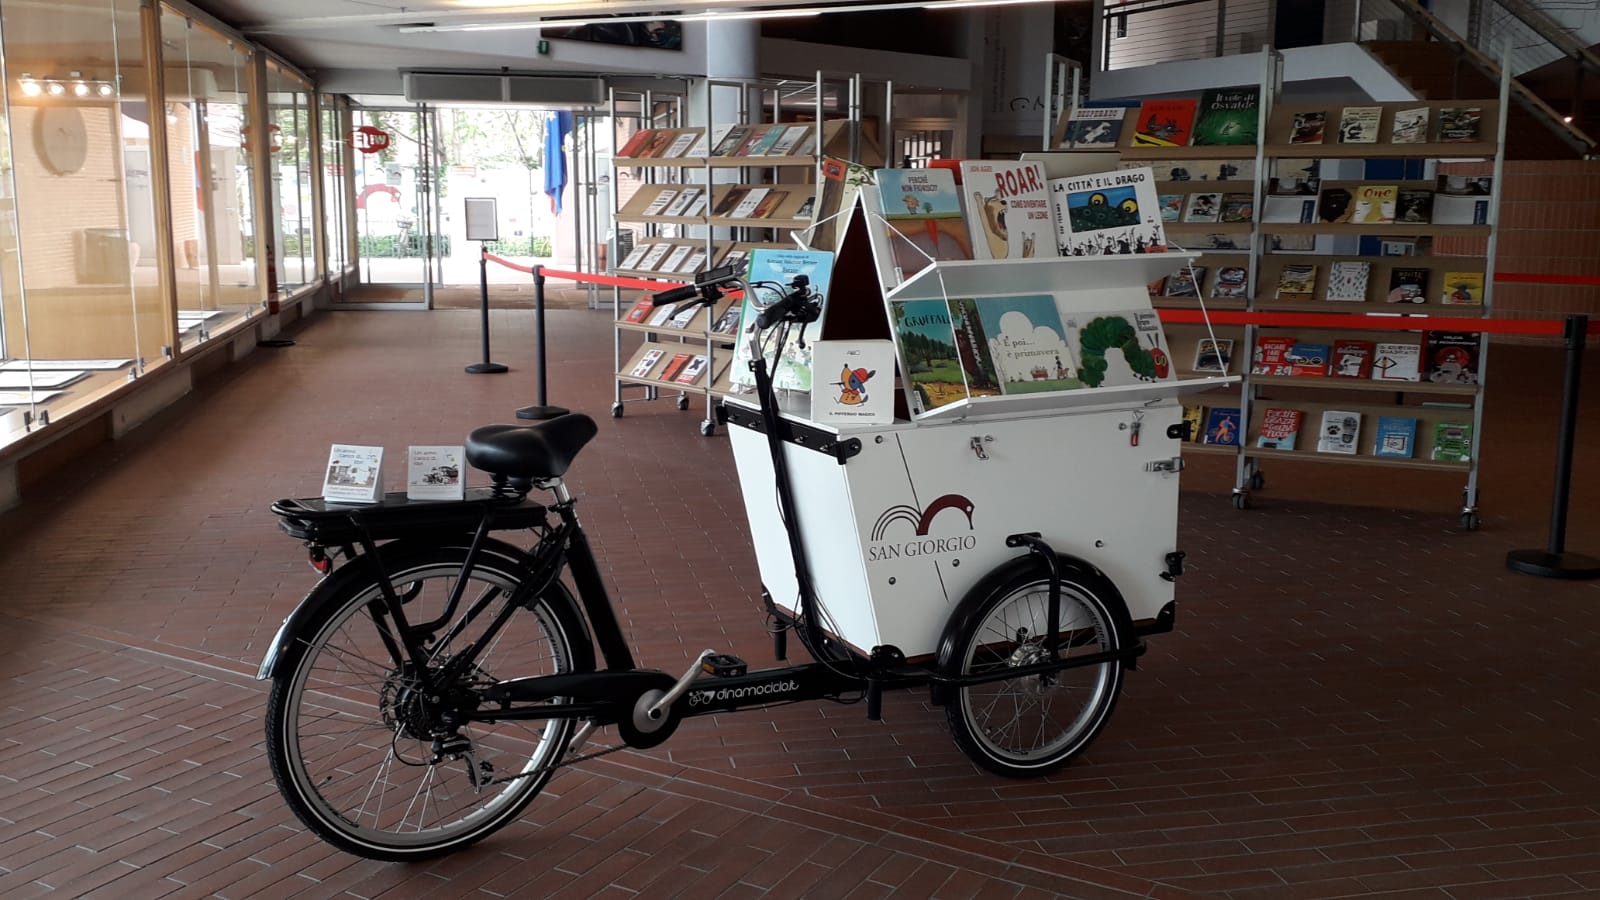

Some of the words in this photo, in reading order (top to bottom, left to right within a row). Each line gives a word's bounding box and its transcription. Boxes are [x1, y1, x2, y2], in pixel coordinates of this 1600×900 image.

[994, 164, 1044, 198] ROAR!
[1053, 183, 1065, 193] LA
[1096, 179, 1102, 188] E
[1104, 177, 1113, 187] IL
[1115, 173, 1145, 185] DRAGO
[868, 543, 901, 561] SAN
[904, 535, 976, 557] GIORGIO
[716, 680, 800, 700] dinamociclo.it
